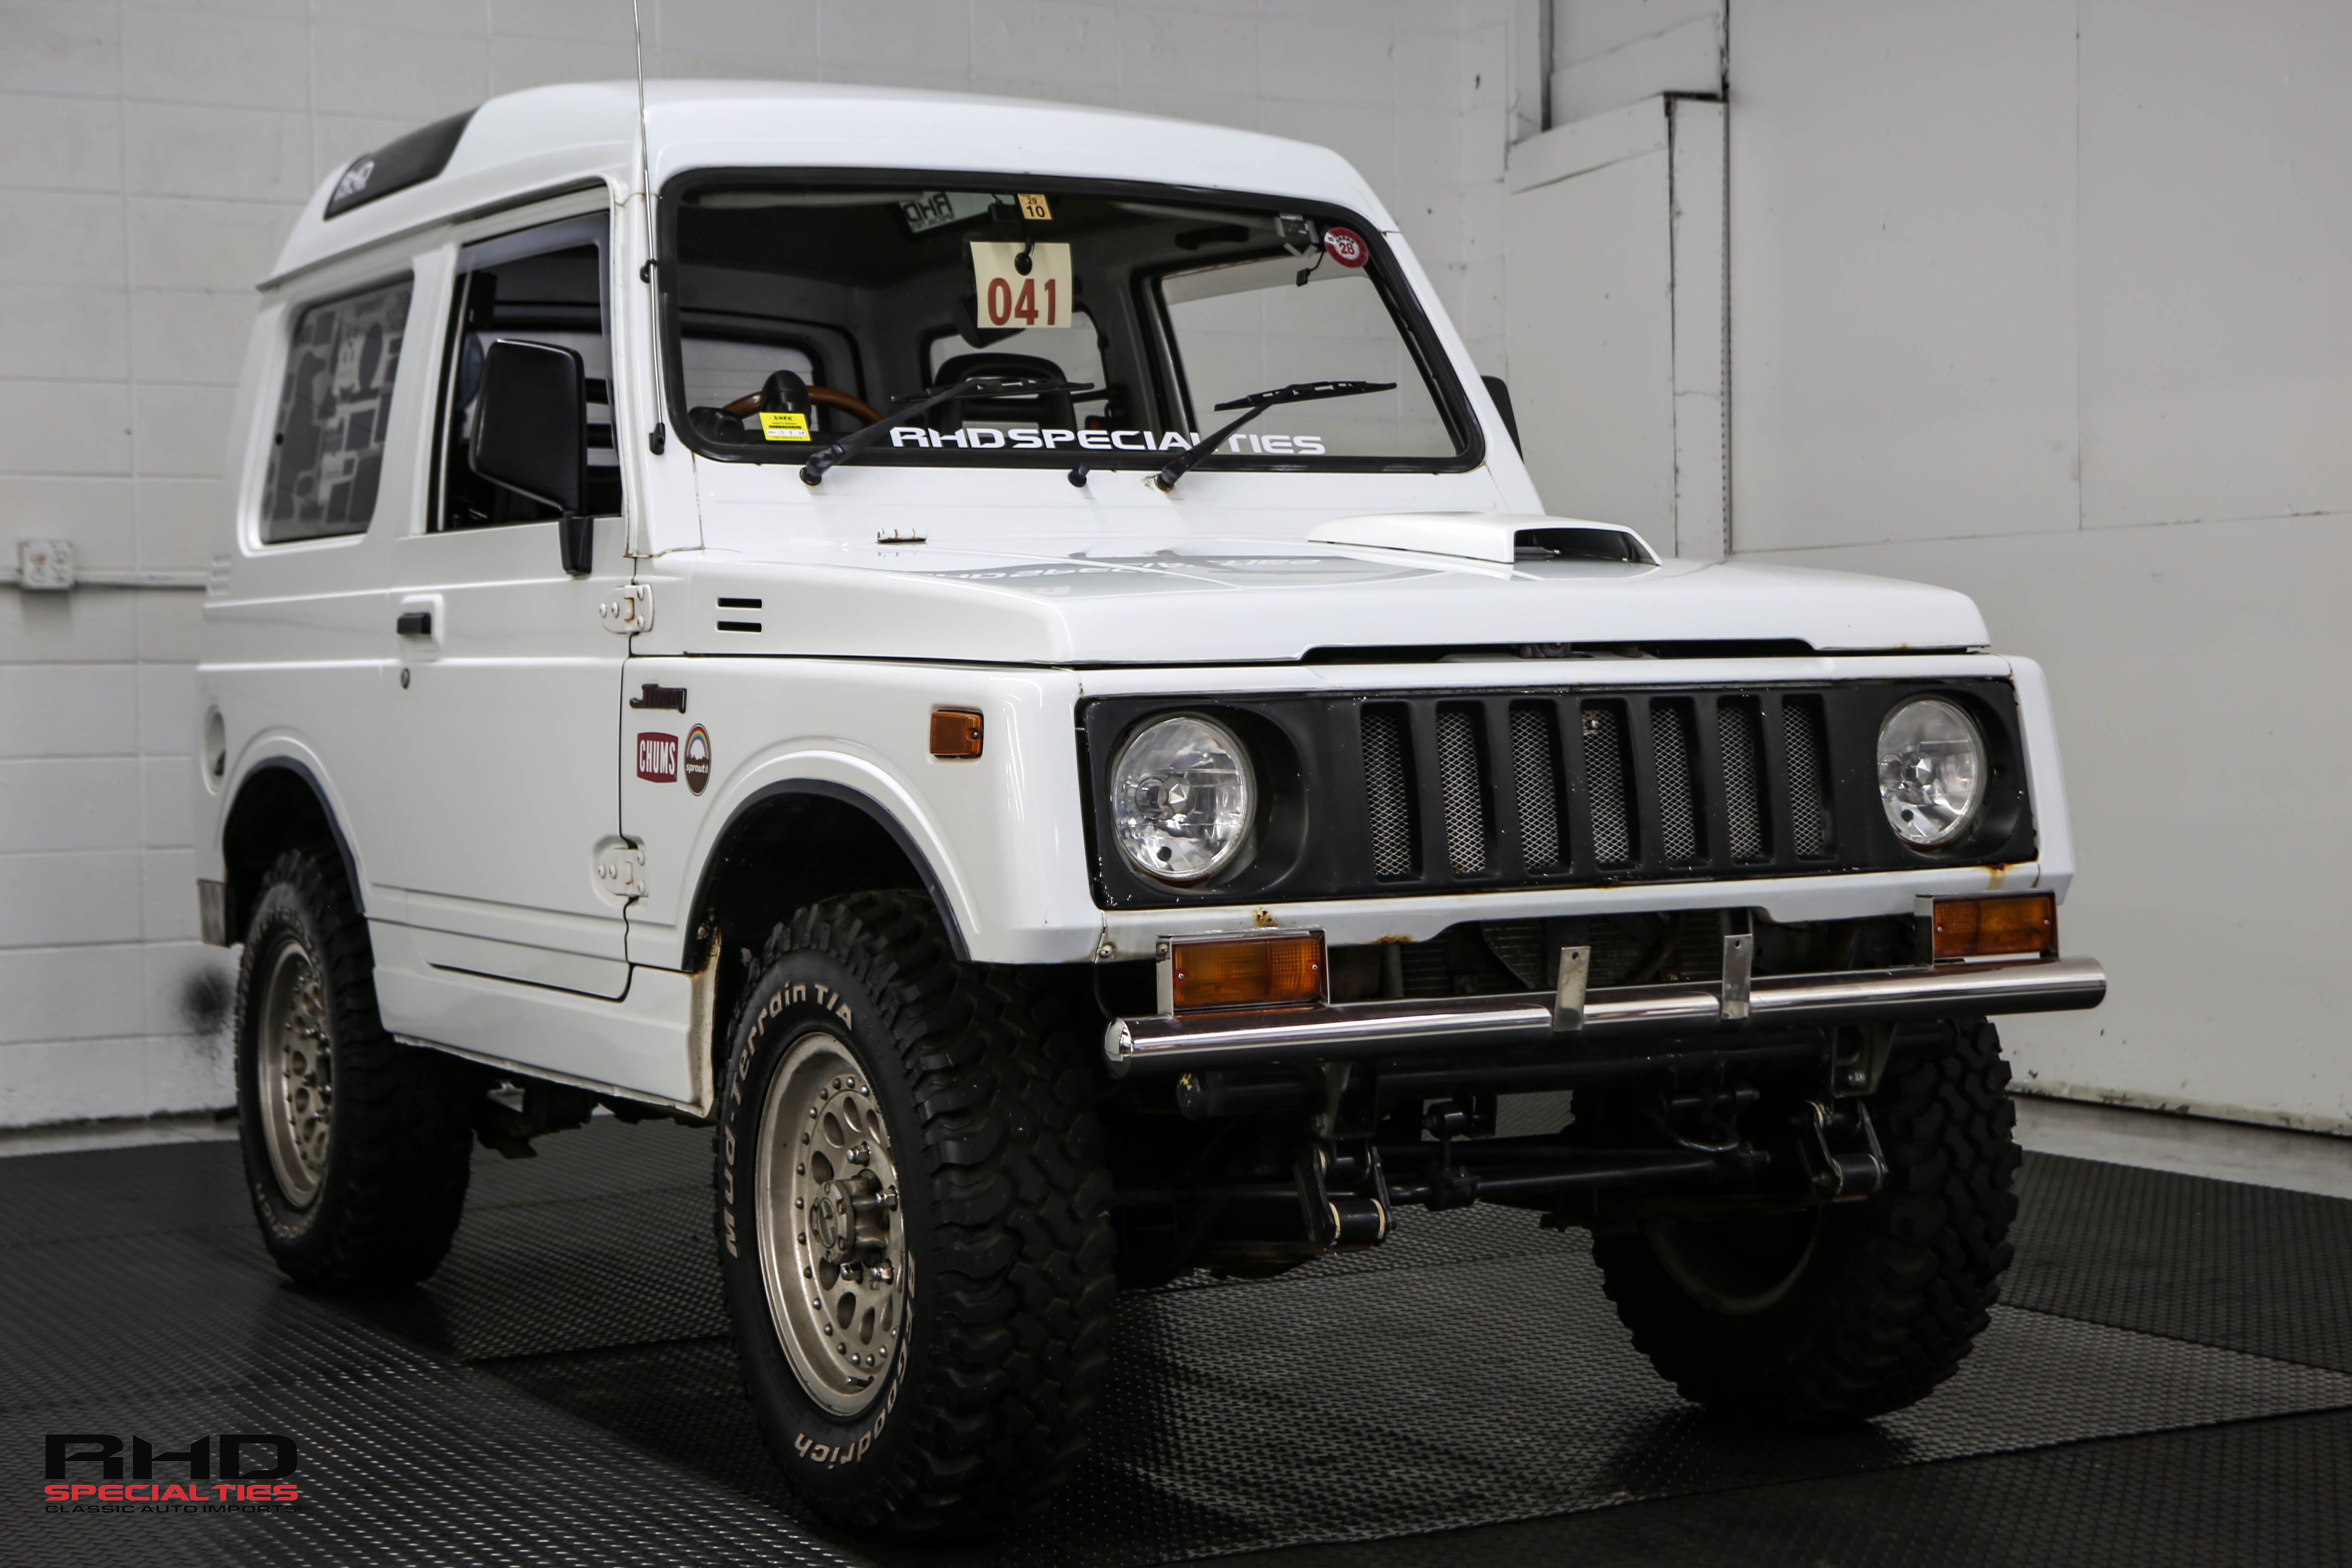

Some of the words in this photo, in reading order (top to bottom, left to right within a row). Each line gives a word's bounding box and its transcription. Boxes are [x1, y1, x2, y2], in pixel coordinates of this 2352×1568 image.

[1026, 205, 1045, 217] 10
[1339, 242, 1355, 255] 28
[988, 278, 1056, 325] 041
[639, 739, 675, 775] CHUMS
